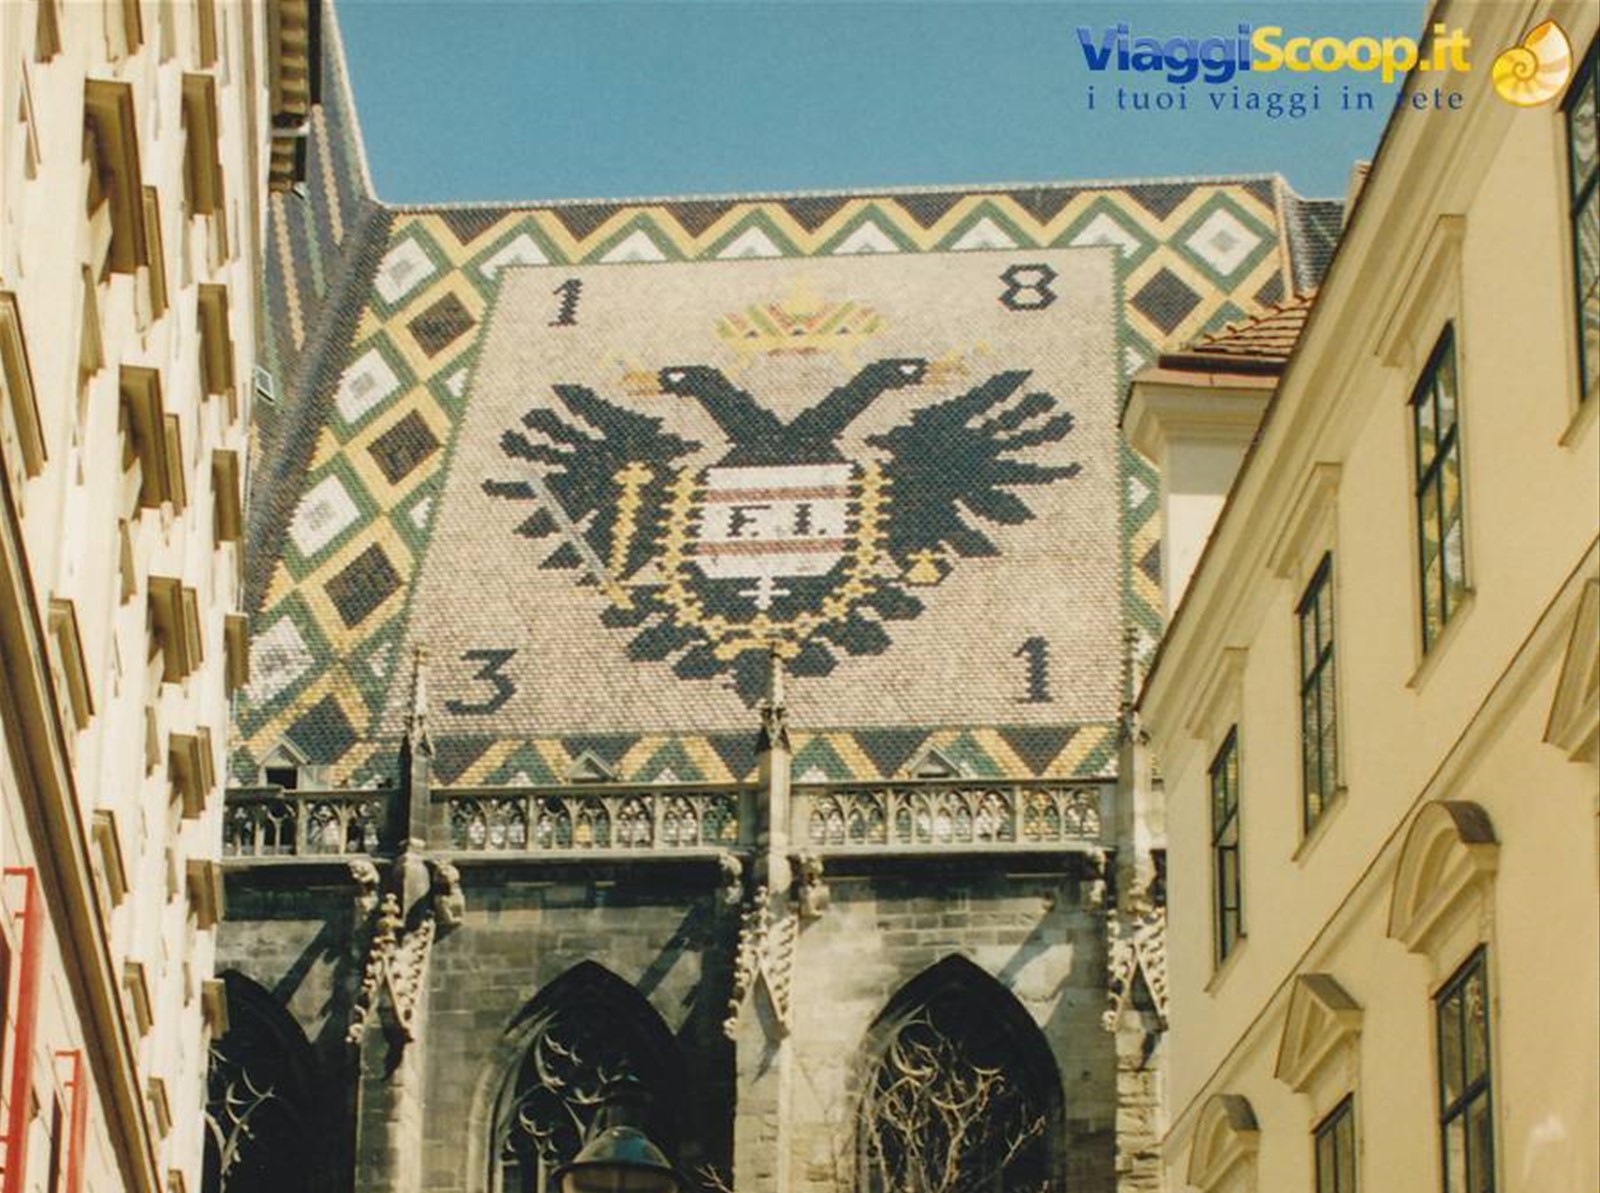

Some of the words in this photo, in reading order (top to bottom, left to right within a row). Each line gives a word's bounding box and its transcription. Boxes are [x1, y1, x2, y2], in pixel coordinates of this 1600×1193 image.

[548, 277, 583, 327] 1
[999, 263, 1058, 310] 8
[445, 647, 519, 714] 3
[1013, 636, 1053, 703] 1
